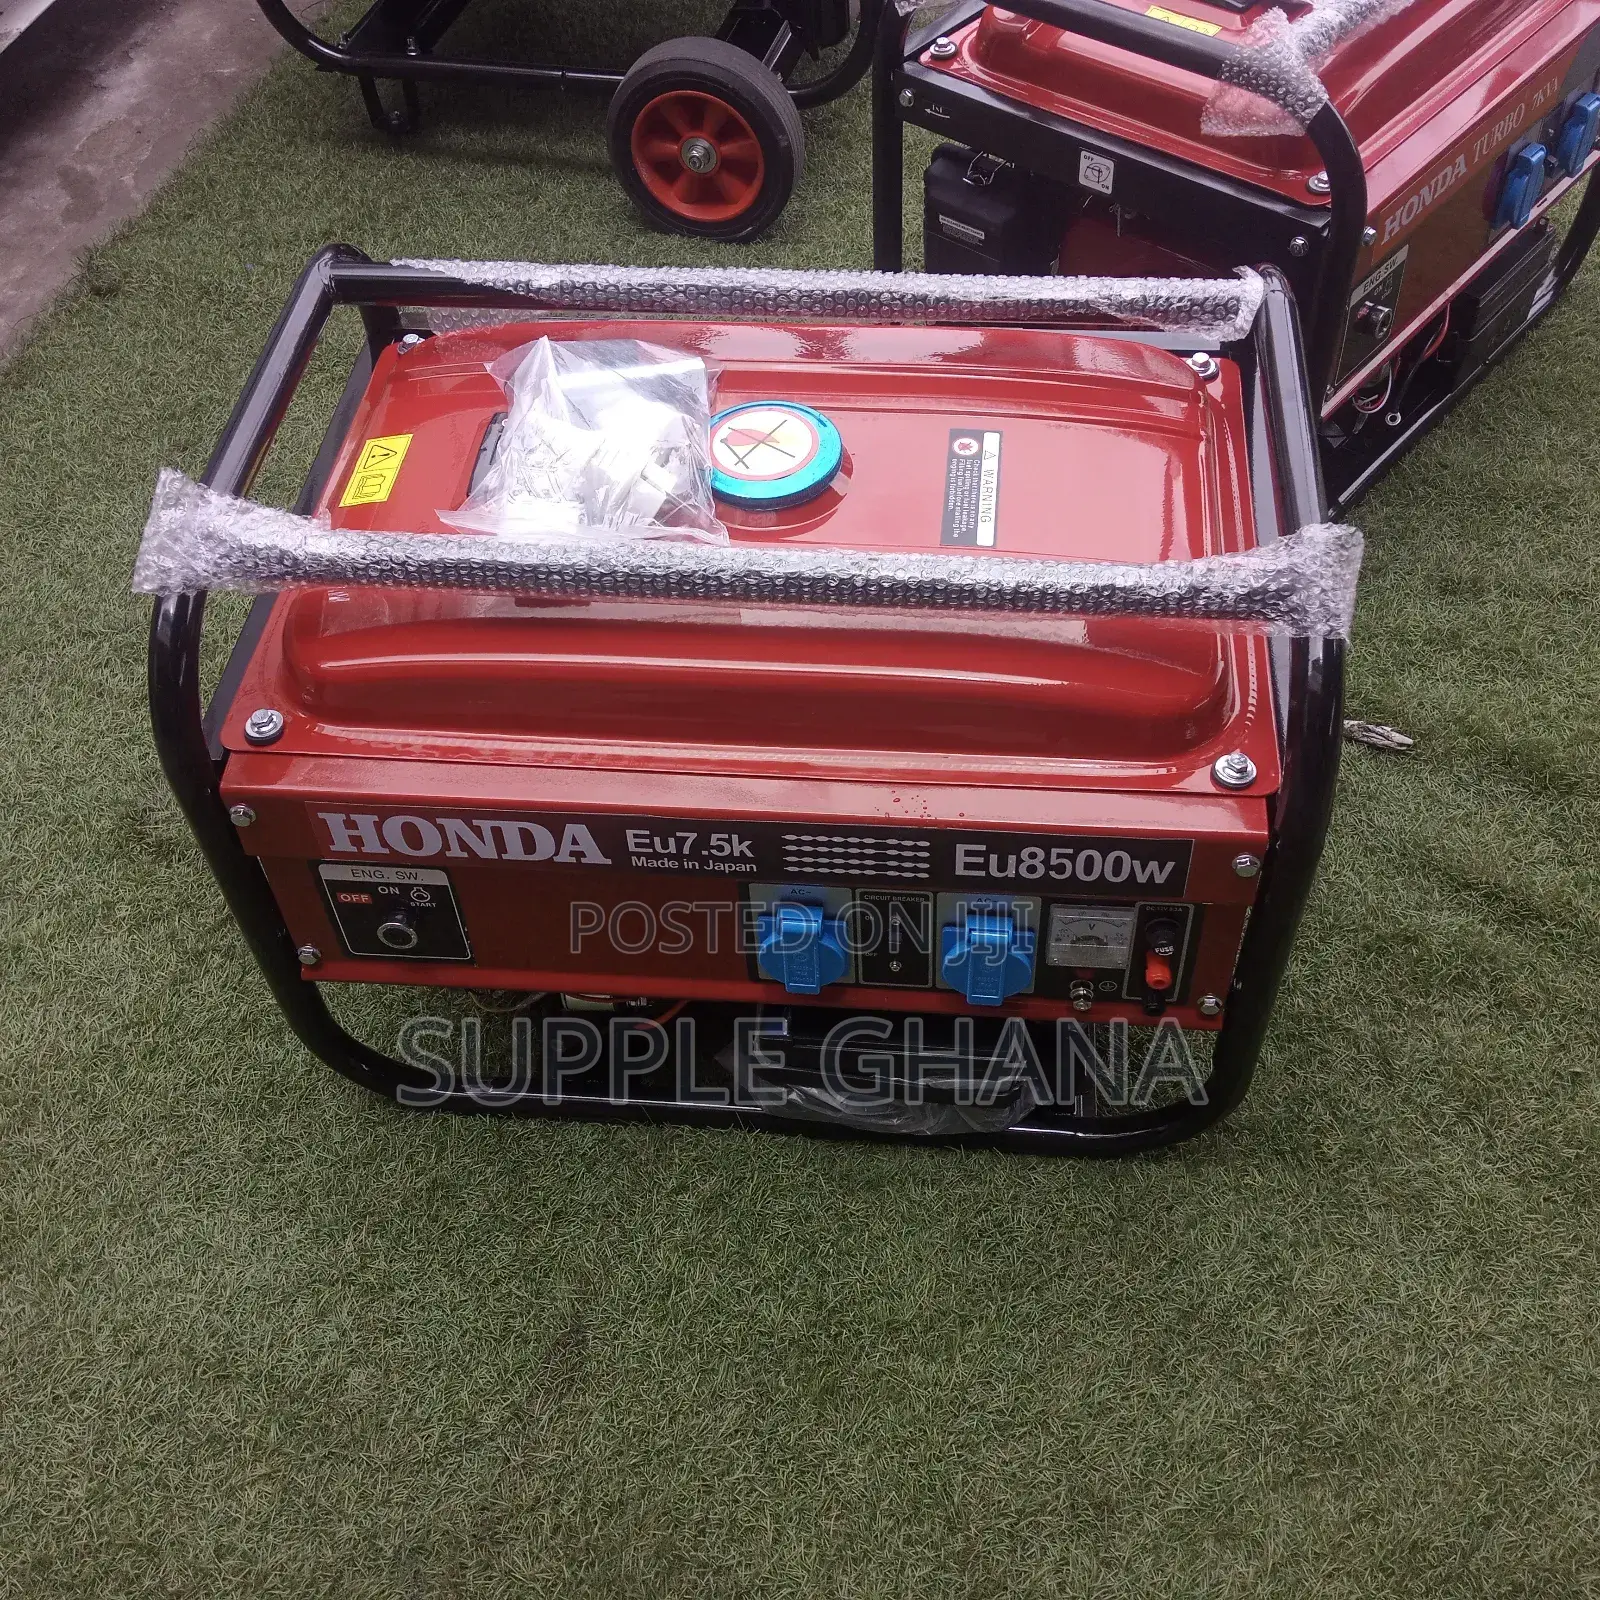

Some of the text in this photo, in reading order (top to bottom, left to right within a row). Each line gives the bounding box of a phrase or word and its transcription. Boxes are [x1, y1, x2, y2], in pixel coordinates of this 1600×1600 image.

[1083, 154, 1094, 162] OFF
[1381, 153, 1468, 246] HONDA
[1471, 102, 1525, 165] TURBO
[981, 469, 995, 523] WARNING
[317, 812, 612, 865] HONDA
[625, 829, 755, 858] Eu7.5k
[631, 856, 757, 874] Made in Japan
[955, 843, 1176, 884] Eu8500w
[351, 868, 424, 882] ENG. SW.
[340, 894, 369, 902] OFF
[378, 886, 399, 895] ON
[892, 895, 925, 903] BREAKER
[1088, 923, 1096, 931] V
